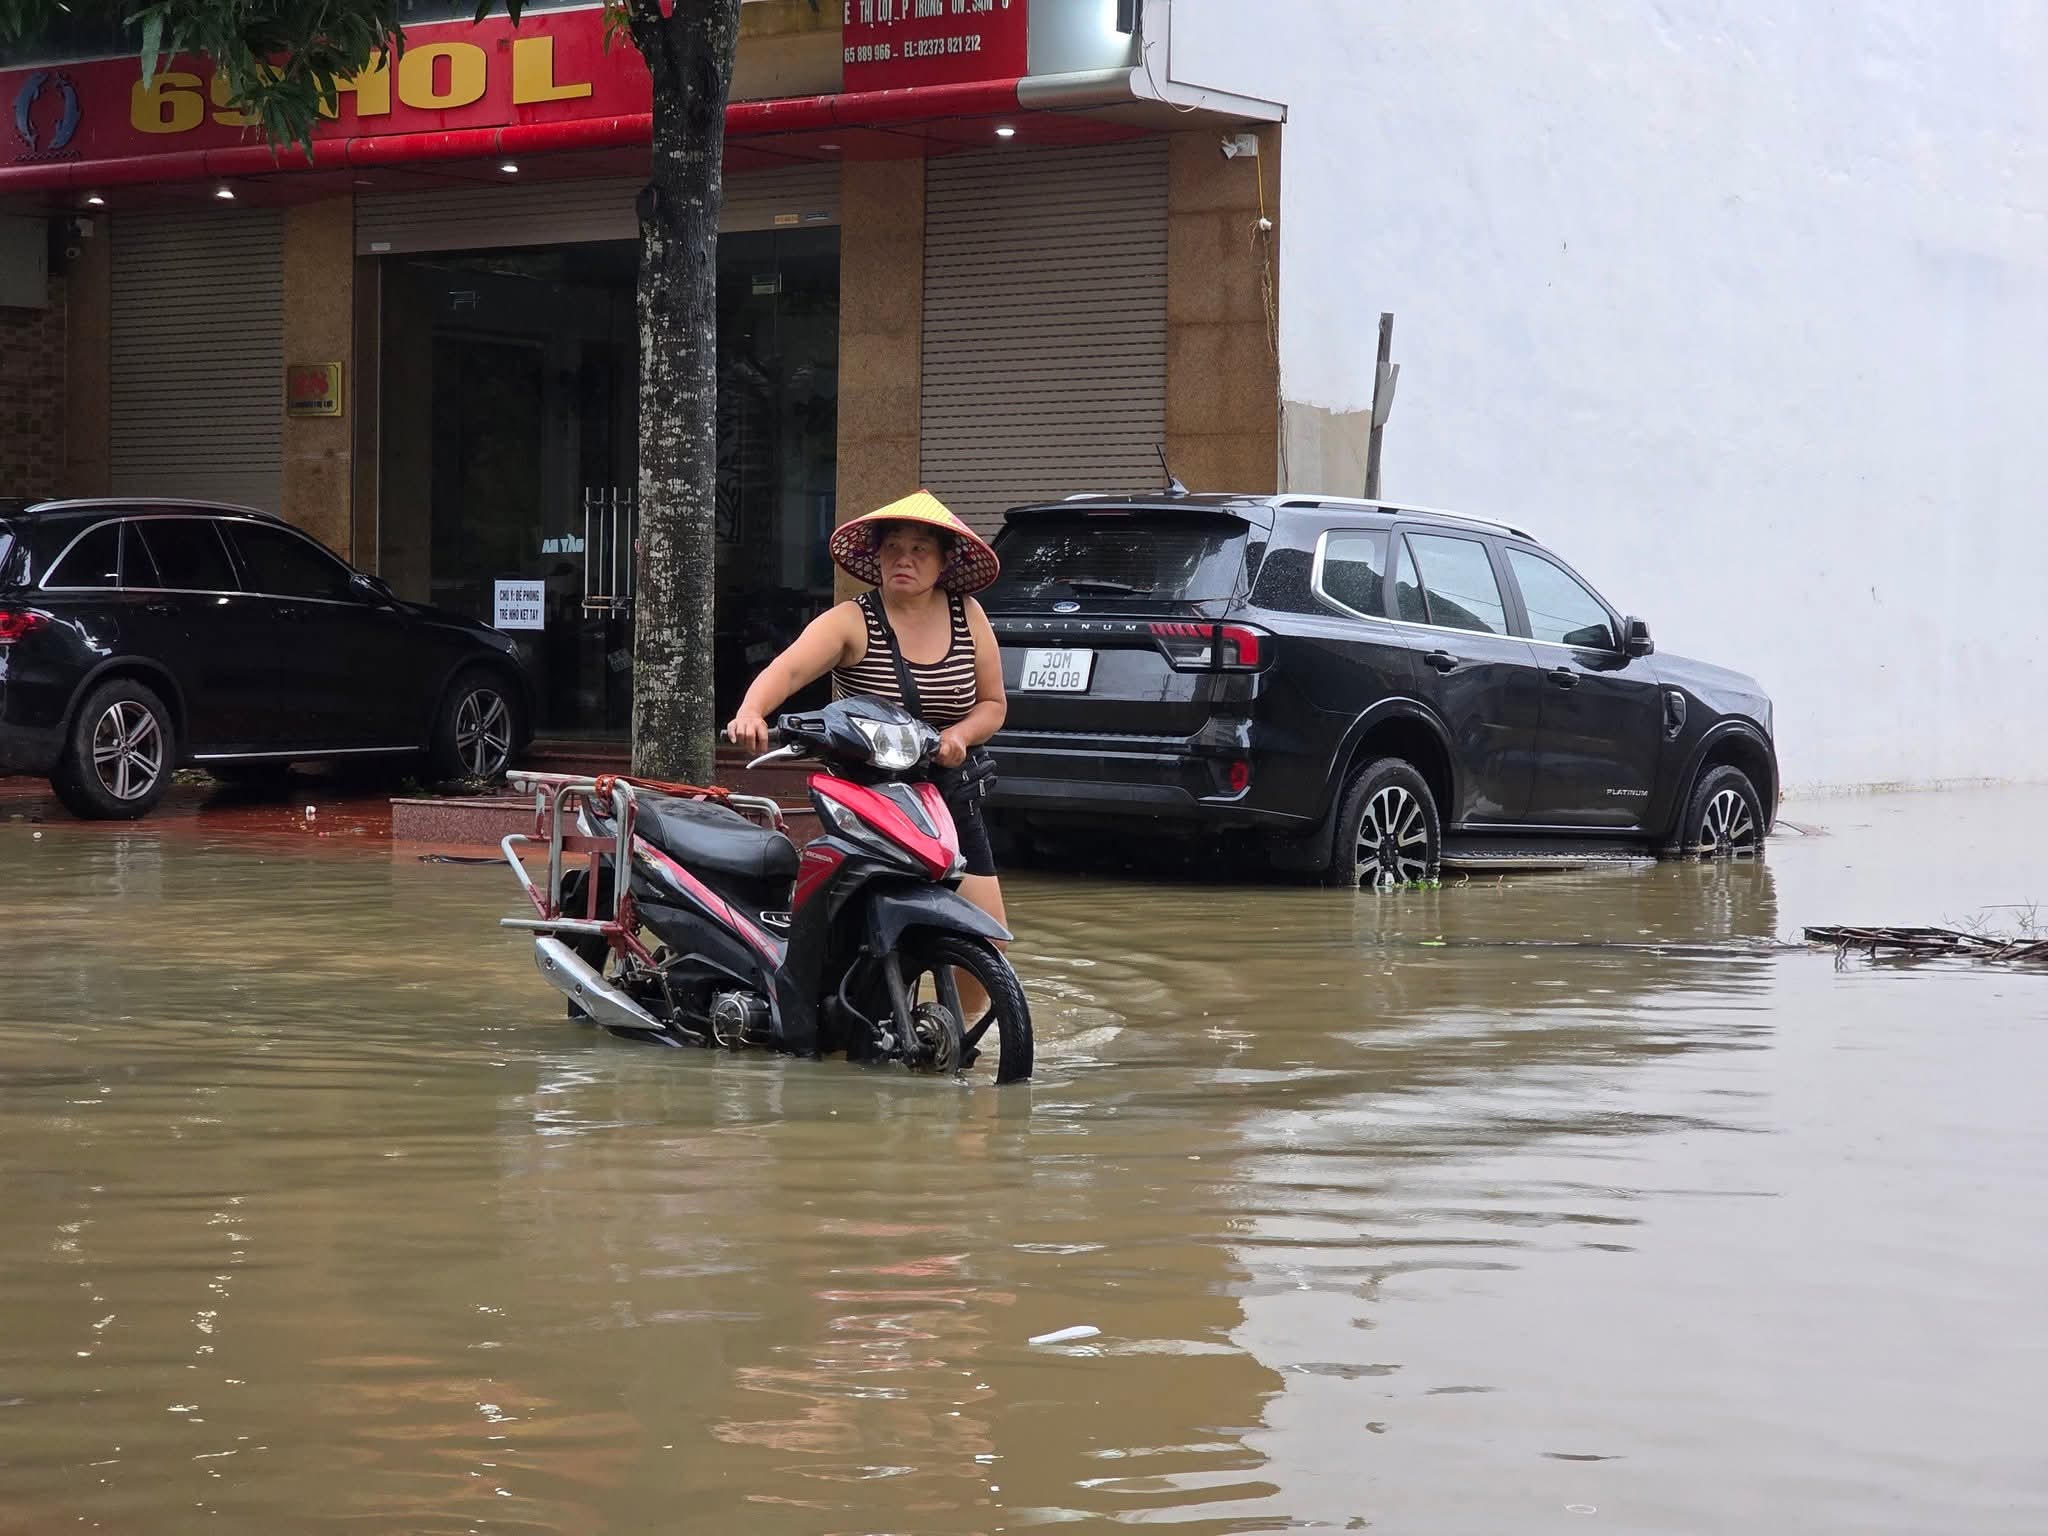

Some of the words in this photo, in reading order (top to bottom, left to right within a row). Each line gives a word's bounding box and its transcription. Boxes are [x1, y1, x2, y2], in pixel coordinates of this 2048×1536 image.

[1042, 652, 1073, 669] 30M
[1028, 671, 1080, 688] 049.08
[1607, 788, 1649, 797] PLATINUM
